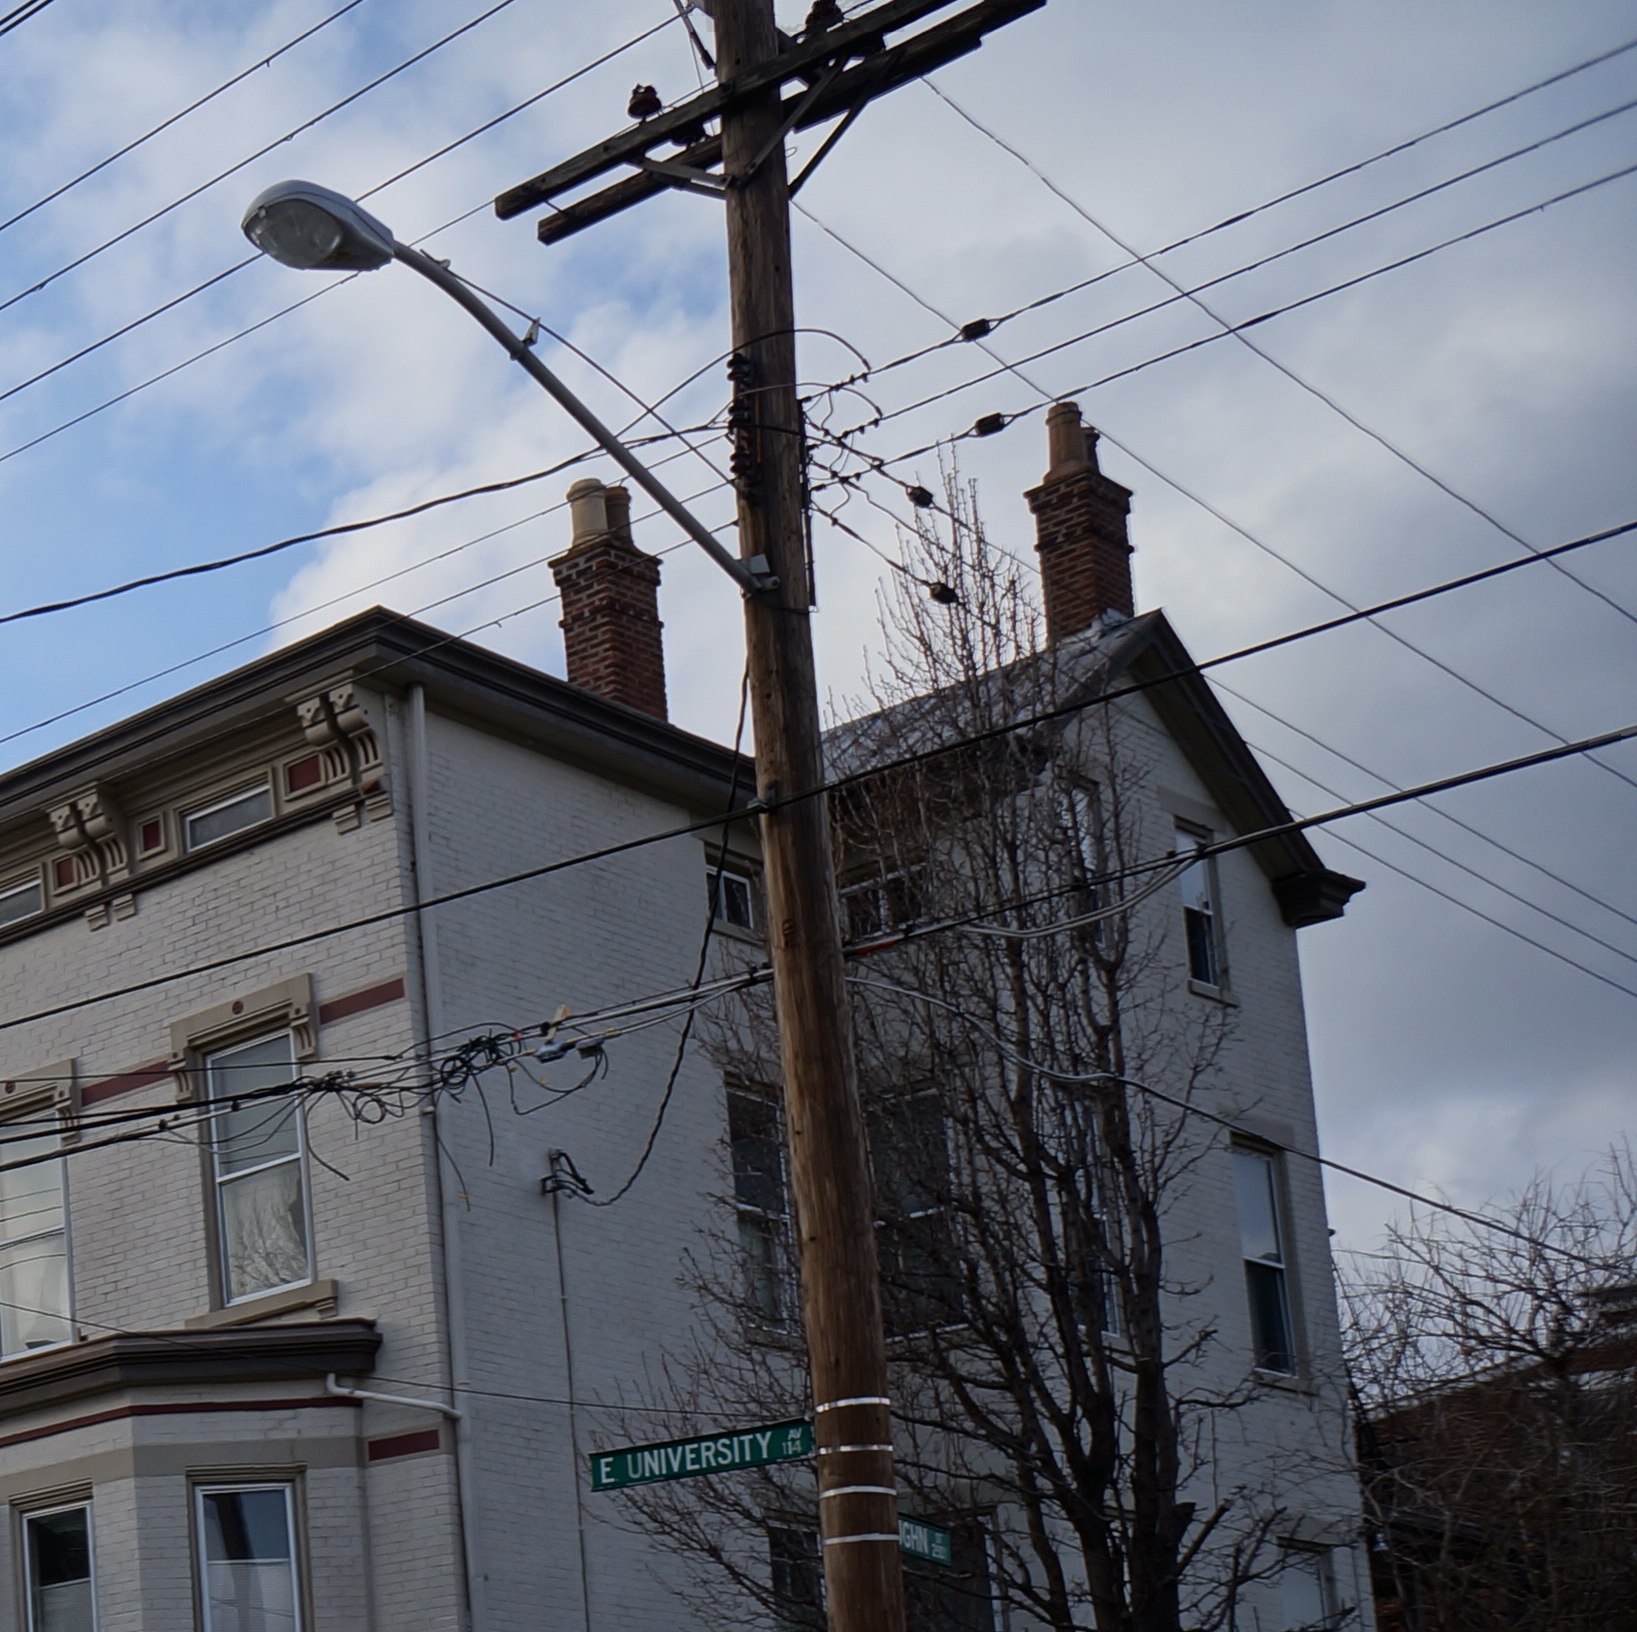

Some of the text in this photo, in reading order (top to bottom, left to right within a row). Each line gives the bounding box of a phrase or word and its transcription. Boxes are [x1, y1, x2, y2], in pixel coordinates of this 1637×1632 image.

[787, 1427, 802, 1440] AV
[782, 1440, 802, 1455] 114
[600, 1431, 772, 1484] E UNIVERSITY
